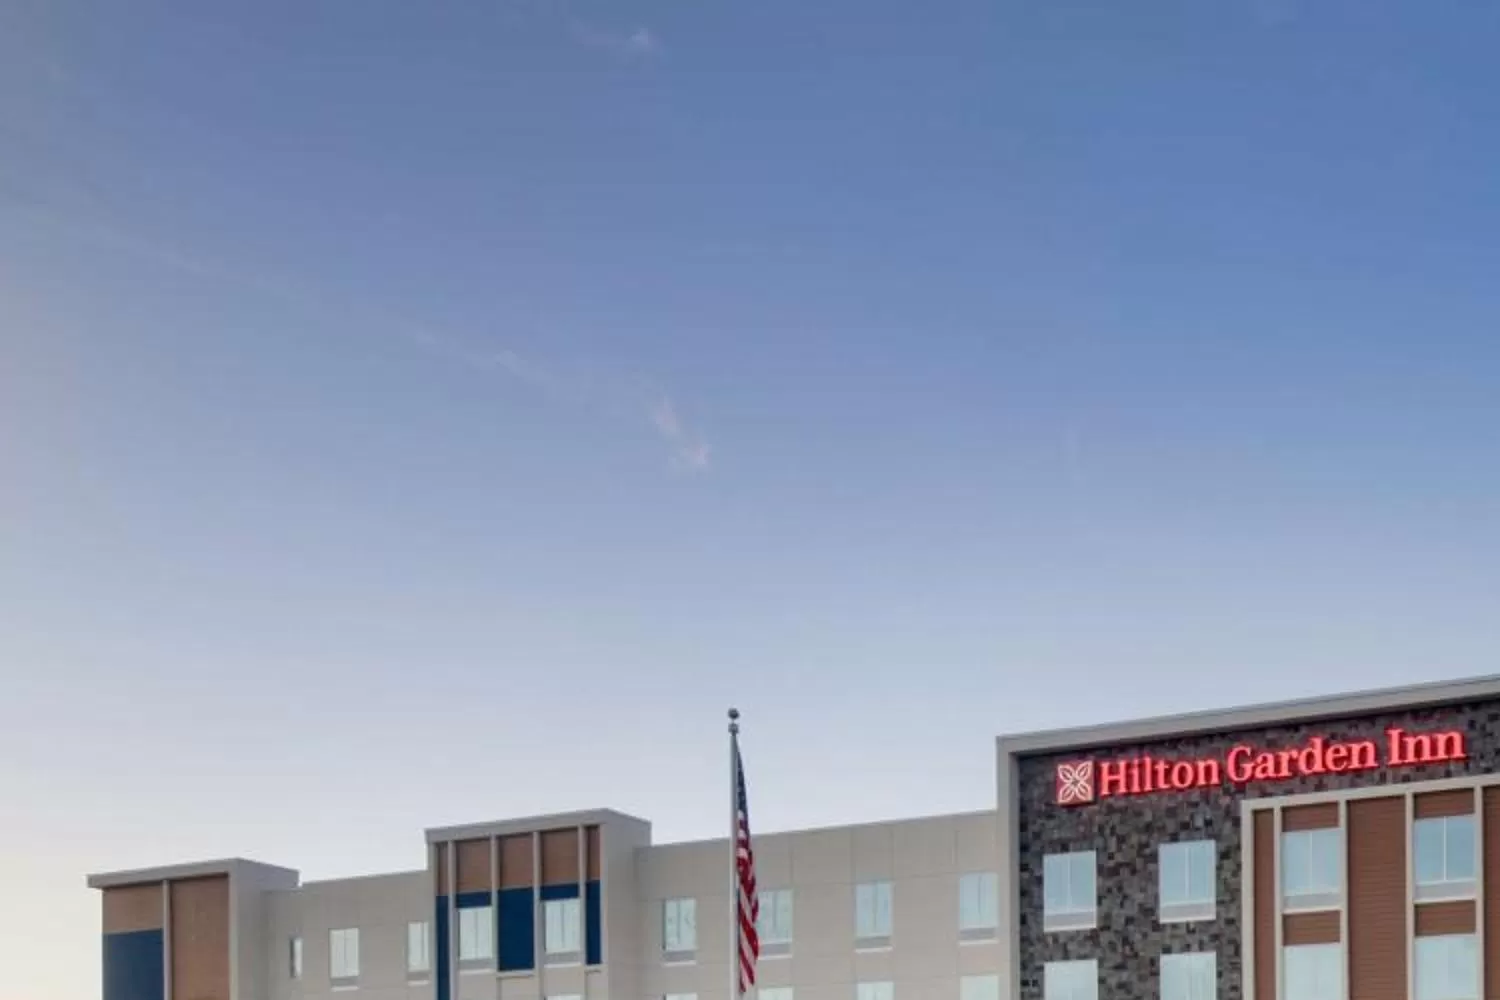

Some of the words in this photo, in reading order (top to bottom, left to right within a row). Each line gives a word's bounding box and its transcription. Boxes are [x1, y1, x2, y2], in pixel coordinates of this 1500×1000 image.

[1100, 755, 1221, 796] Hilton
[1226, 736, 1379, 783] Garden
[1384, 726, 1467, 766] Inn
